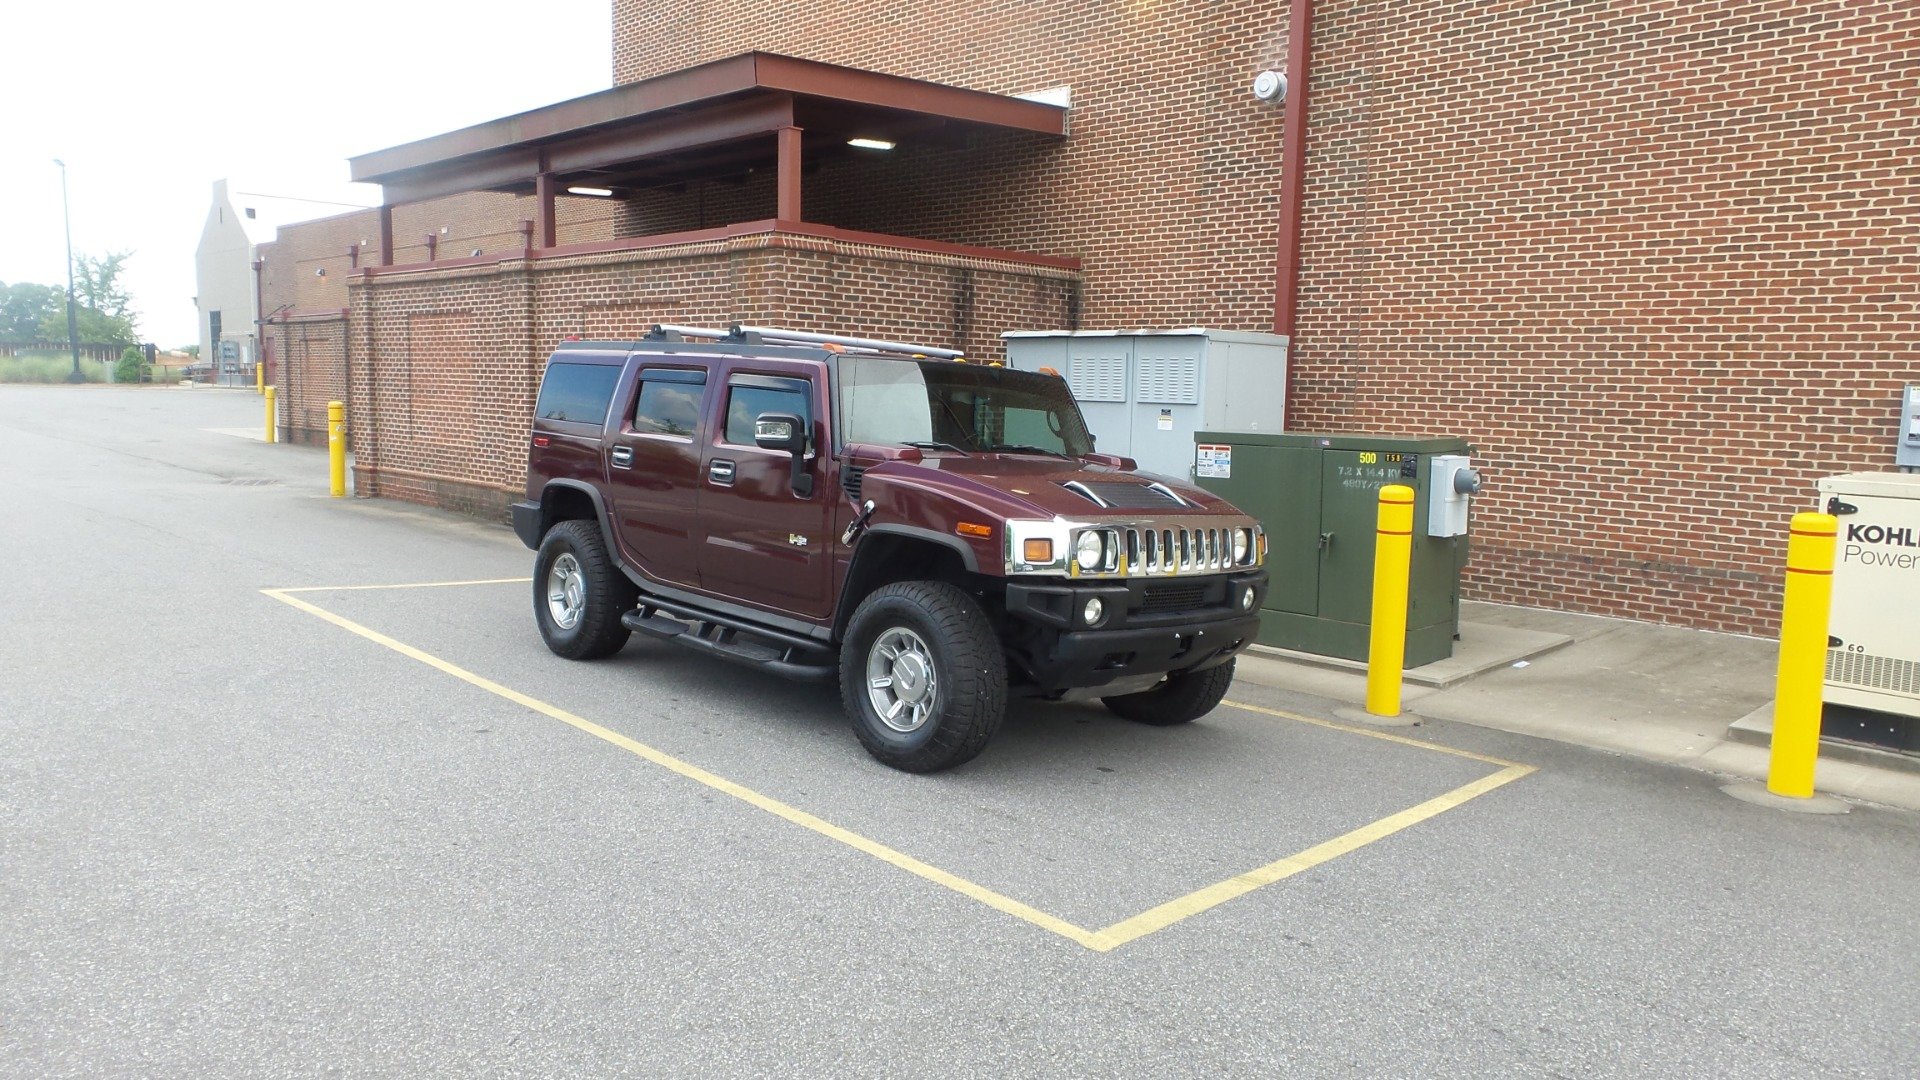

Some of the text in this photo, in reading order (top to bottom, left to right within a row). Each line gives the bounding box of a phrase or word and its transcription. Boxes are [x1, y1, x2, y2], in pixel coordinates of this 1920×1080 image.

[1359, 453, 1377, 464] 500
[1338, 466, 1352, 476] 7.2
[1355, 467, 1362, 476] X
[1847, 524, 1920, 547] KOHL
[1844, 545, 1920, 569] Power
